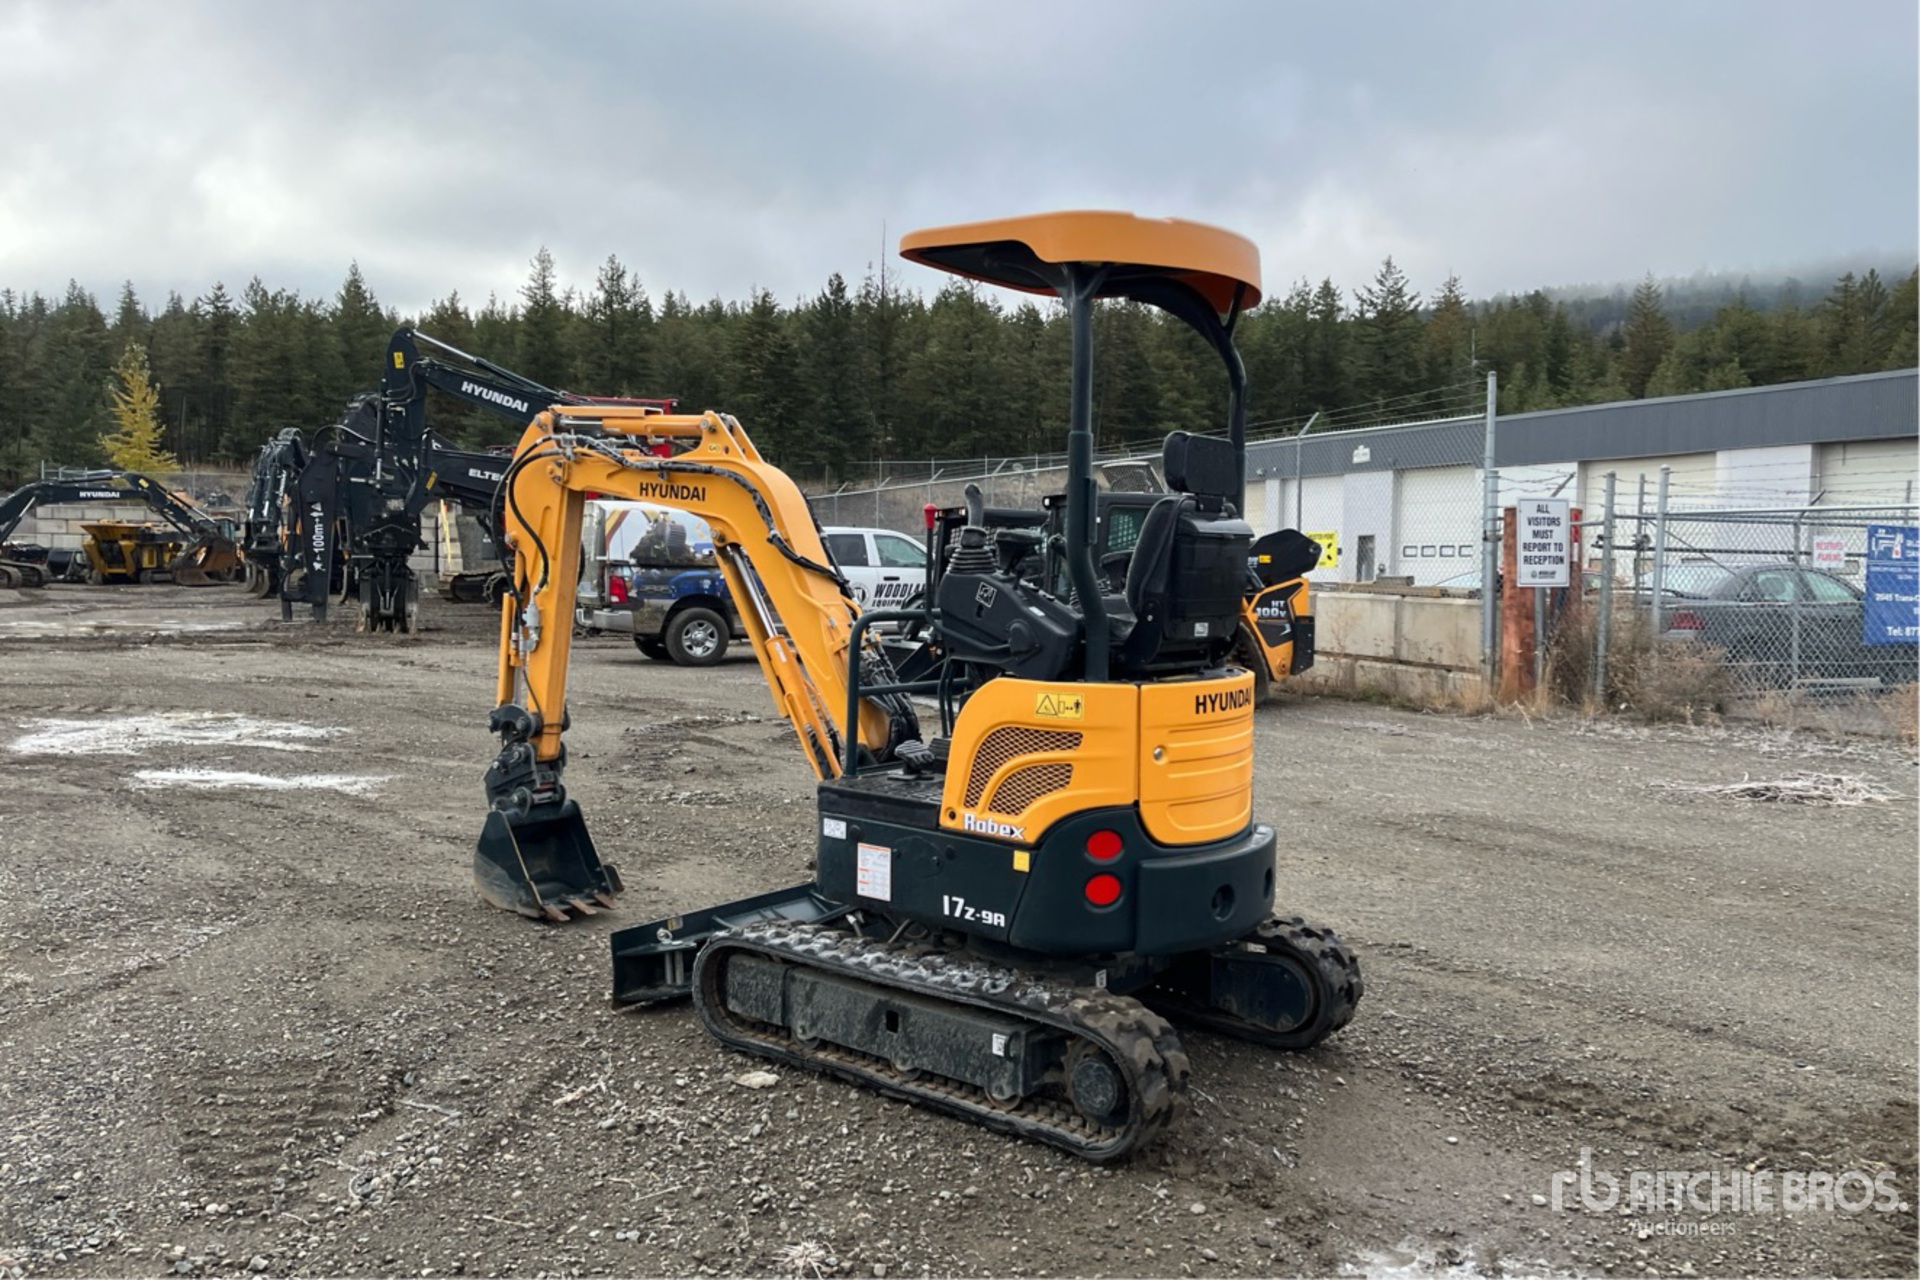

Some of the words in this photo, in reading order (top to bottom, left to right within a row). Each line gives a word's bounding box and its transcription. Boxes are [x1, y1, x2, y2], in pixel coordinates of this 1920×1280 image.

[461, 381, 529, 413] HYUNDAI
[639, 482, 706, 501] HYUNDAI
[1536, 504, 1550, 514] ALL
[1527, 517, 1561, 526] VISITORS
[312, 523, 325, 553] 100m
[1532, 530, 1554, 539] MUST
[1523, 542, 1551, 552] REPORT
[1554, 542, 1564, 552] TO
[1523, 555, 1565, 565] RECEPTION
[875, 583, 926, 598] WOODLA
[1195, 686, 1252, 715] HYUNDAI
[964, 813, 1026, 840] Robex
